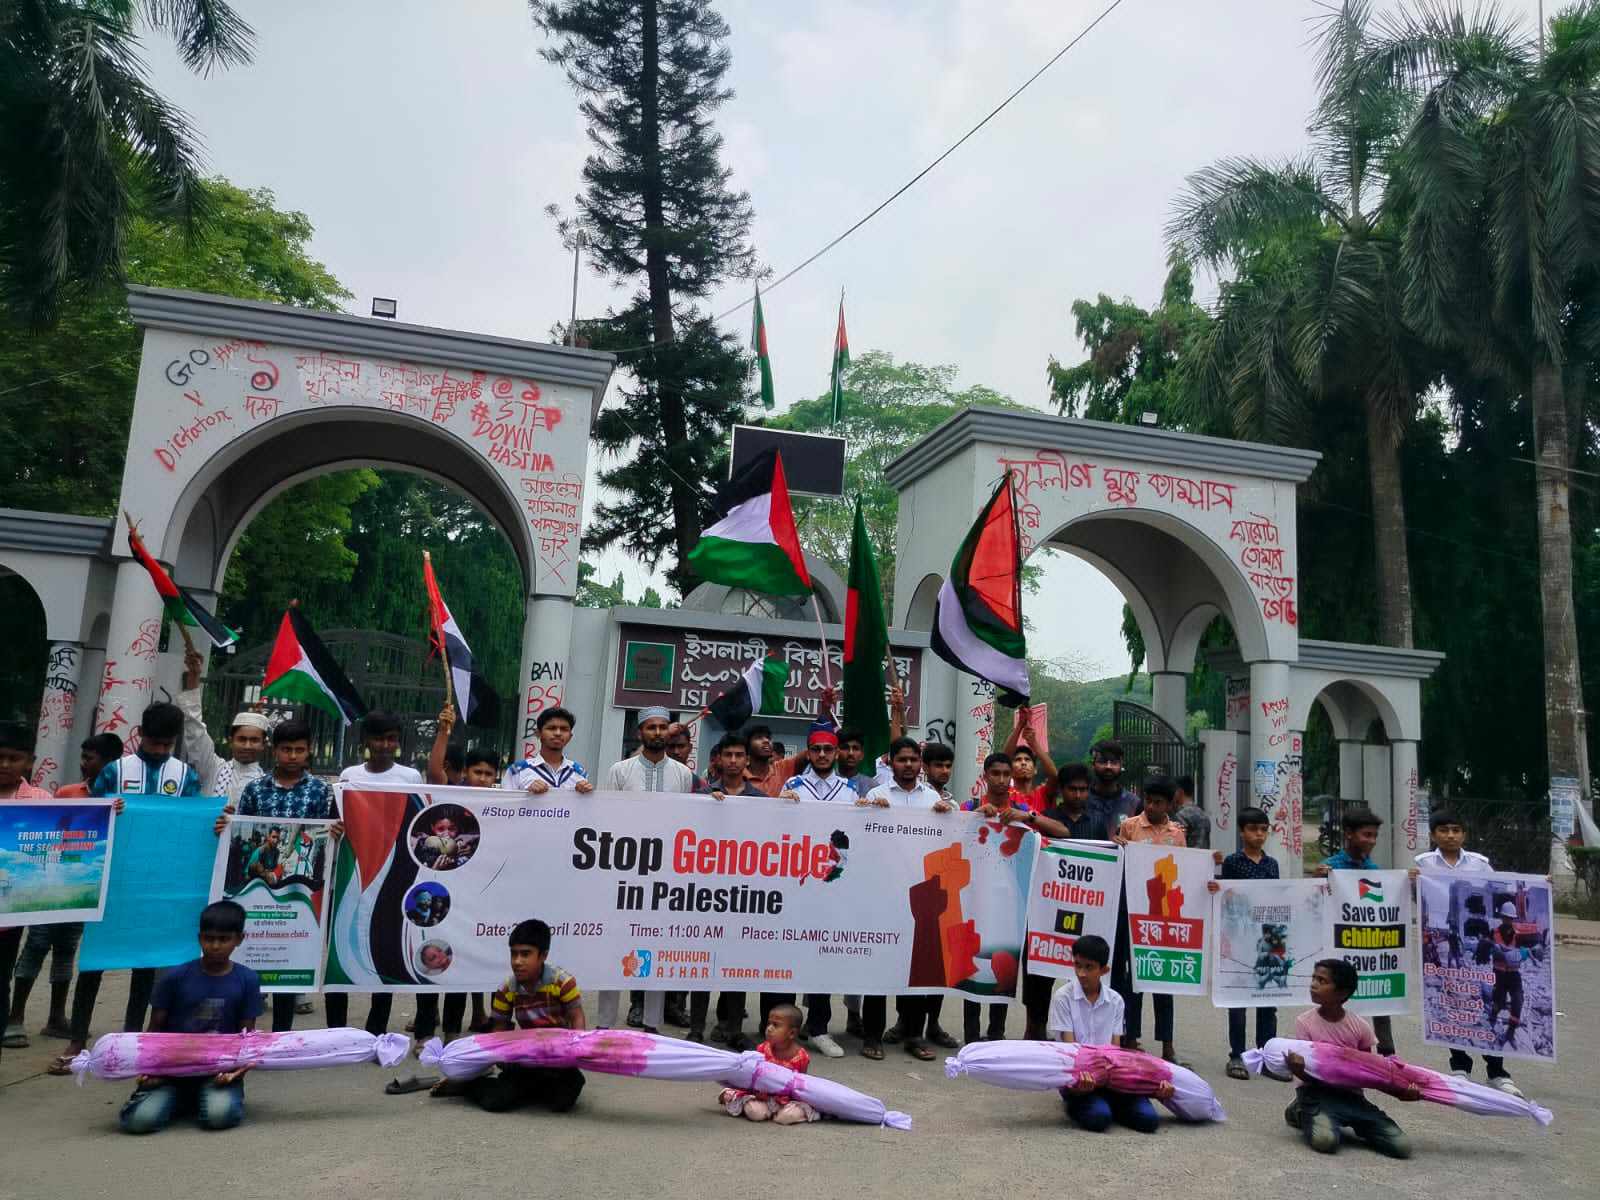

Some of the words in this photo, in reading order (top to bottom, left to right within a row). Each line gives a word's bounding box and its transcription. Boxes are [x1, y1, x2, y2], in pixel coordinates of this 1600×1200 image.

[473, 421, 533, 450] DOWN
[488, 443, 555, 471] HASINA
[684, 634, 768, 660] ইসলামী
[531, 661, 563, 680] BAN
[482, 806, 515, 818] #Stop
[518, 807, 571, 818] Genocide
[17, 831, 43, 841] FROM
[864, 822, 894, 834] #Free
[897, 824, 943, 837] Palestine
[572, 827, 664, 875] Stop
[672, 828, 831, 880] Genocide
[1058, 858, 1094, 882] Save
[616, 880, 644, 910] in
[651, 881, 783, 915] Palestine
[1042, 881, 1105, 907] children
[1063, 913, 1077, 930] of
[1342, 902, 1375, 922] Save
[1379, 906, 1400, 922] our
[572, 922, 604, 936] 2025
[629, 924, 663, 937] Time:
[668, 924, 699, 938] 11:00
[703, 926, 724, 939] AM
[741, 926, 778, 940] Place:
[782, 929, 829, 942] ISLAMIC
[832, 930, 900, 945] UNIVERSITY
[1137, 920, 1165, 945] যুদ্ধ
[1167, 922, 1192, 944] নয়
[1342, 927, 1399, 948] children
[818, 946, 843, 956] (MAIN
[846, 947, 872, 957] GATE)
[1031, 935, 1073, 960] Pales
[1170, 954, 1197, 981] চাই
[1380, 951, 1398, 970] the
[764, 968, 793, 979] MELA
[1424, 963, 1496, 984] Bombing
[1447, 1009, 1479, 1024] Self
